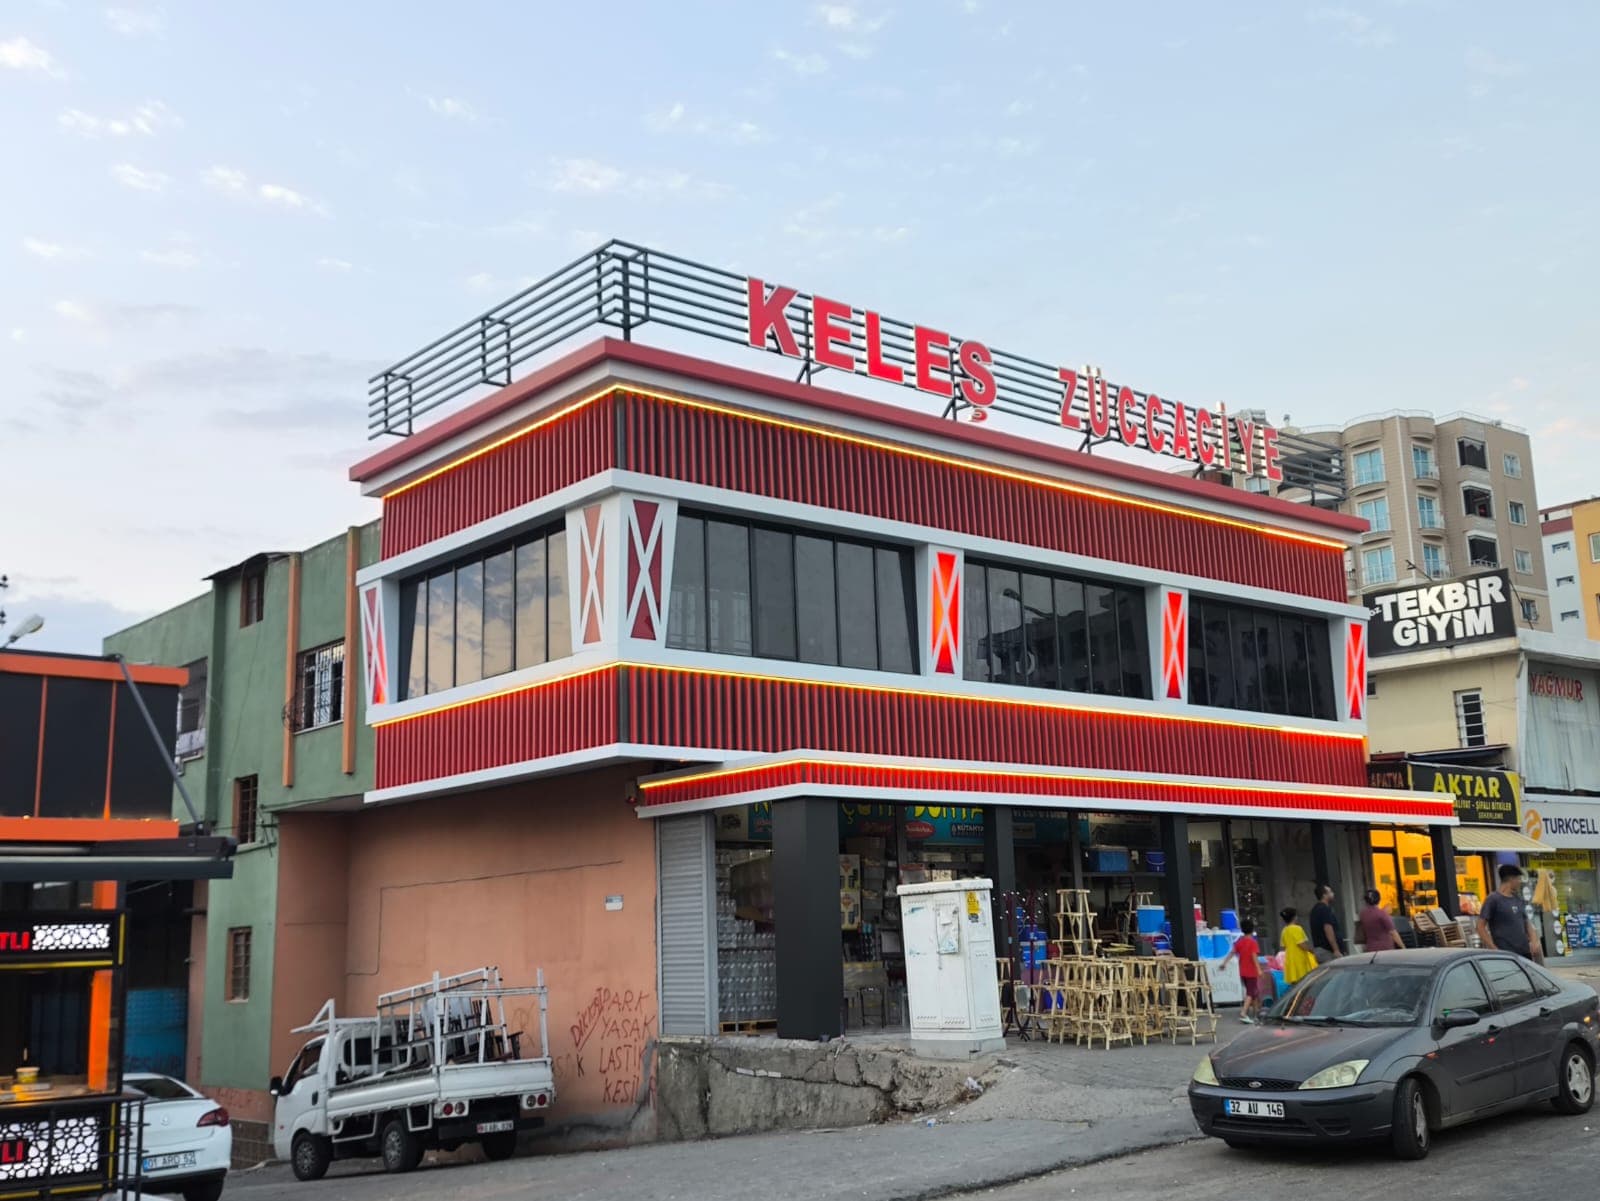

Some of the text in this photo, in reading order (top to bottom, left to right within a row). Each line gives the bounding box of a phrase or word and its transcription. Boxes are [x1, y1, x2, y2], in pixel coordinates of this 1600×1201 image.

[746, 276, 1284, 482] KELEŞ ZÜCCACİYE
[1375, 575, 1507, 622] TEKBİR
[1392, 605, 1495, 647] GİYİM
[1529, 672, 1584, 702] YAĞMUR
[1433, 772, 1501, 798] AKTAR
[1542, 817, 1599, 835] TURKCELL
[603, 988, 650, 1012] PARK
[601, 1014, 656, 1041] YASAK
[1230, 1101, 1284, 1117] 32 AU 146
